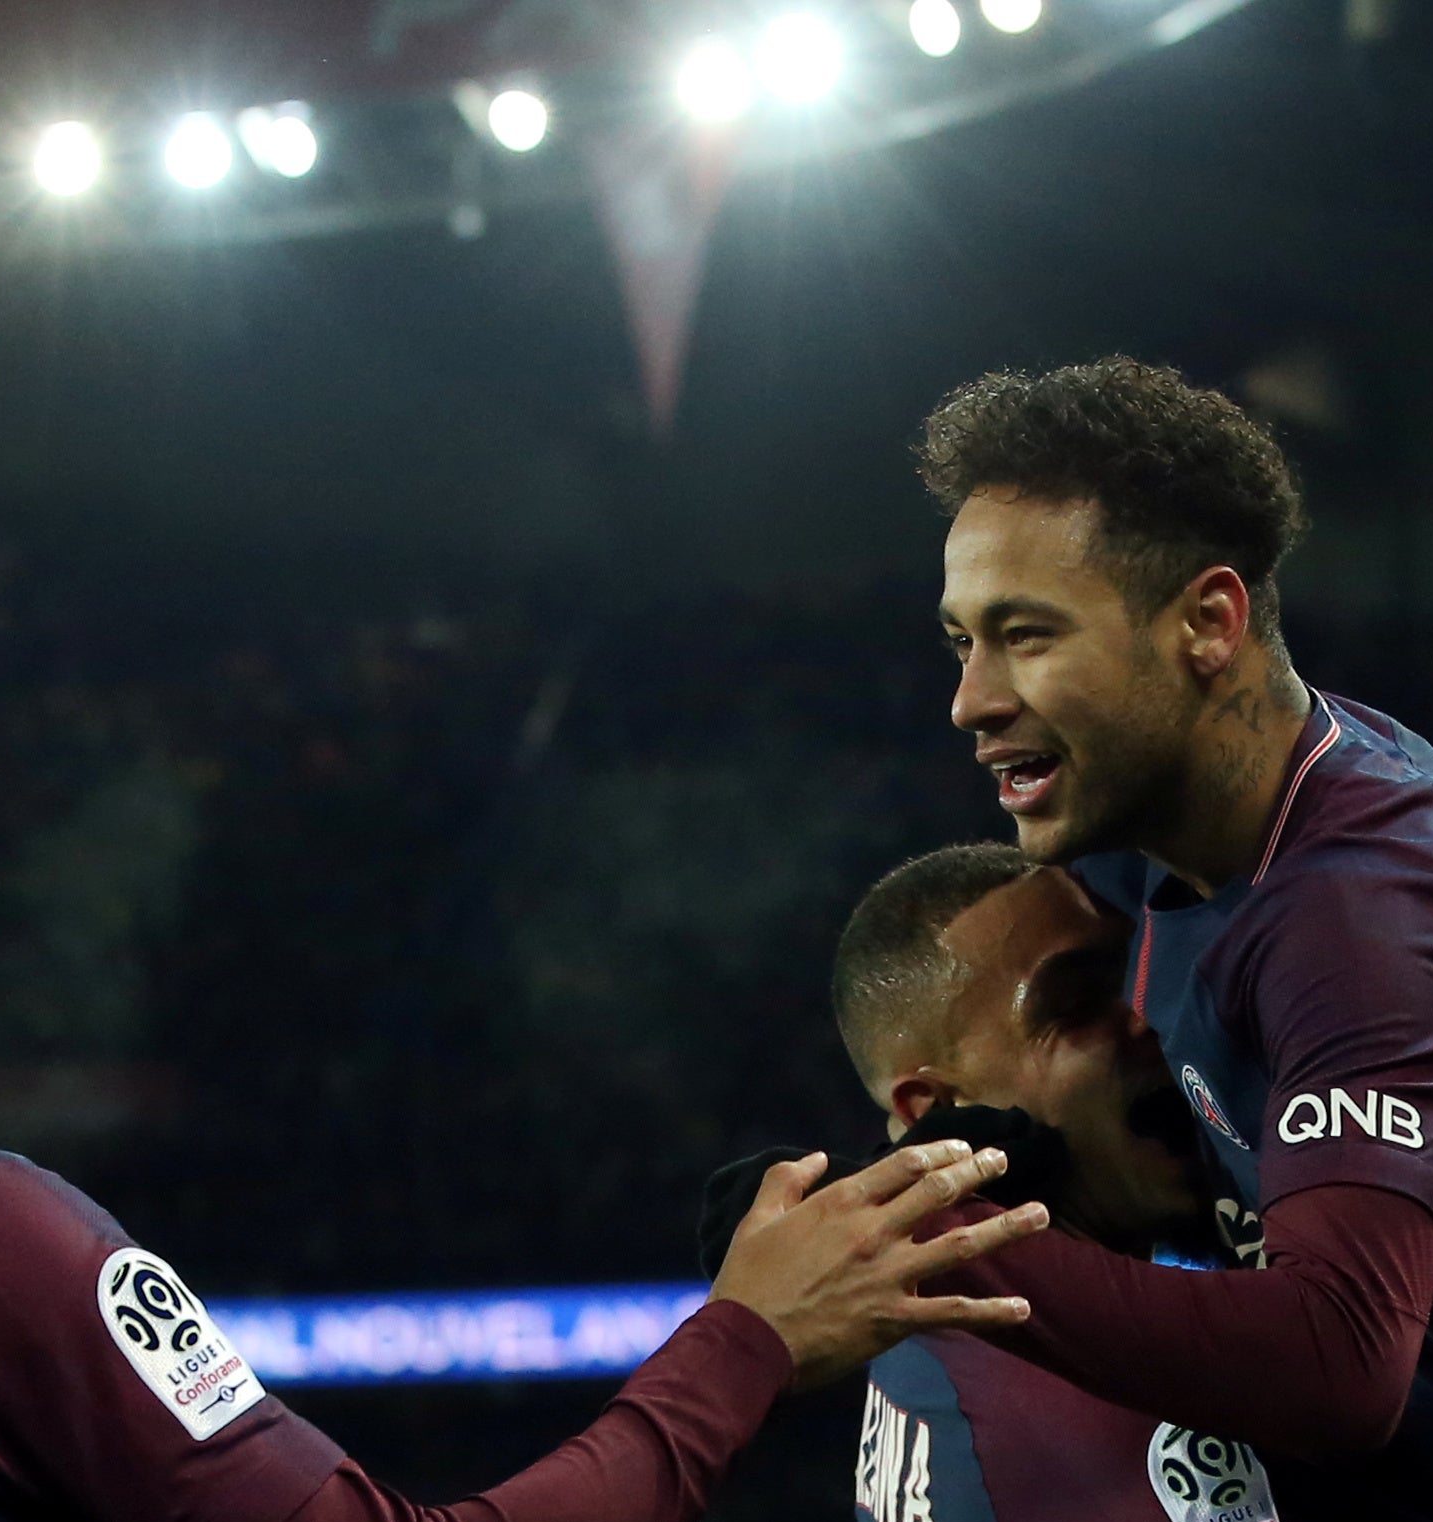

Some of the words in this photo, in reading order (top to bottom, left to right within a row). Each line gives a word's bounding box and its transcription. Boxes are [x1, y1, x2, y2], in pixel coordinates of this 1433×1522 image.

[1277, 1087, 1425, 1149] QNB
[167, 1344, 218, 1386] LIGUE
[175, 1355, 243, 1406] Conforama
